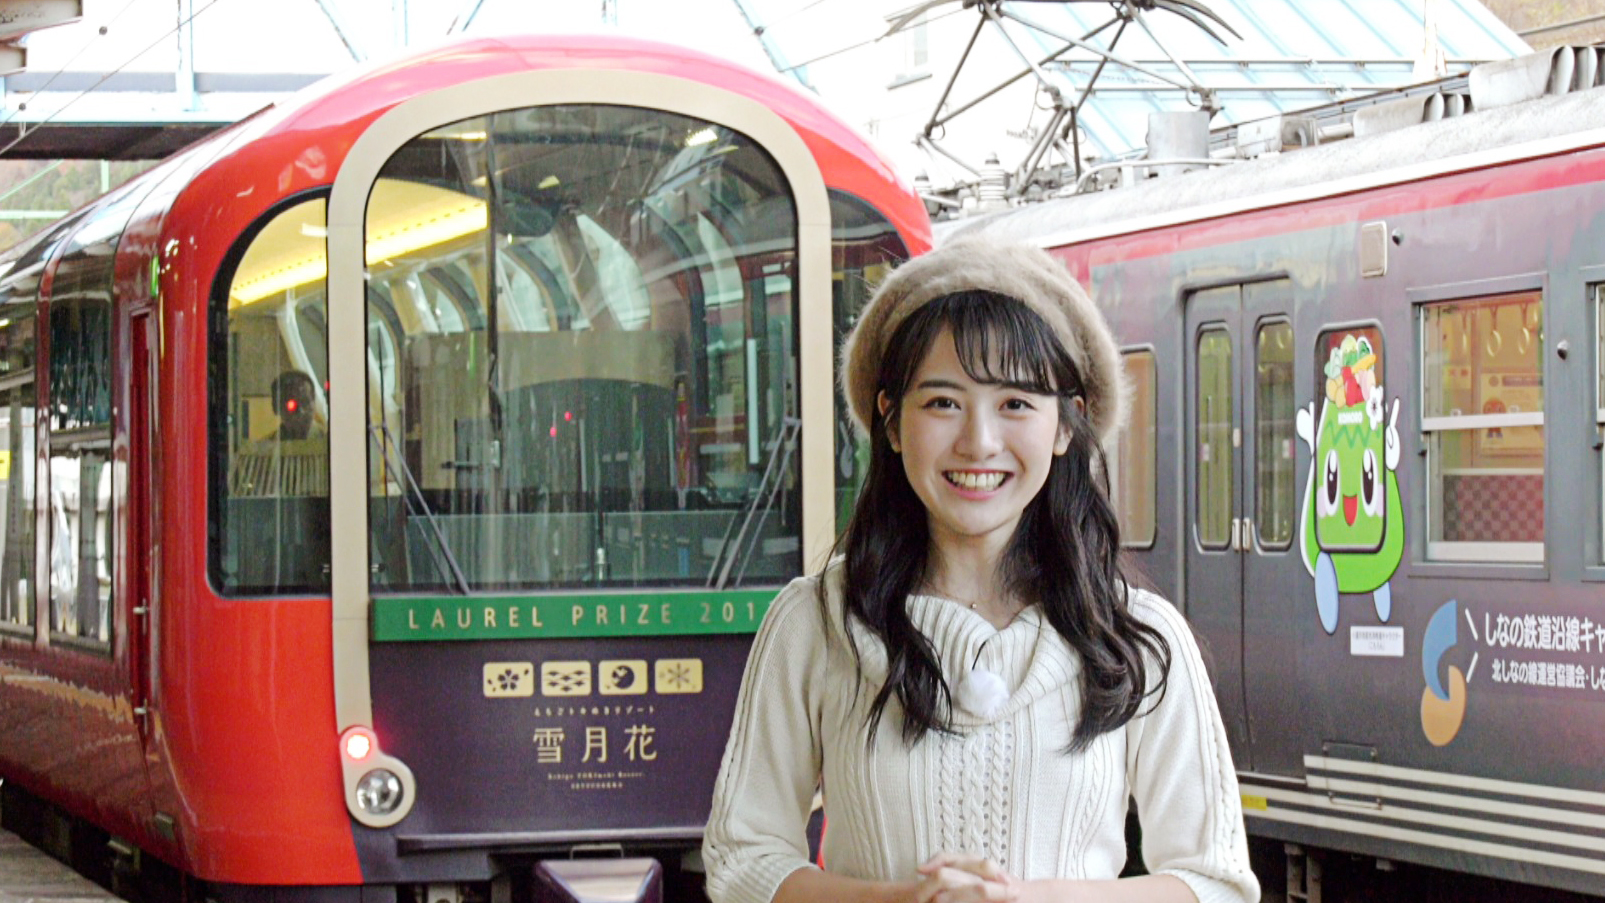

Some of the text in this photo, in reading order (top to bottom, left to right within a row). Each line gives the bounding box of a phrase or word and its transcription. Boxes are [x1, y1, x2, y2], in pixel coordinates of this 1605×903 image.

[408, 601, 772, 629] LAUREL PRIZE 201
[1485, 611, 1605, 653] しなの鉄道沿線キャ
[533, 724, 658, 763] 雪月花
